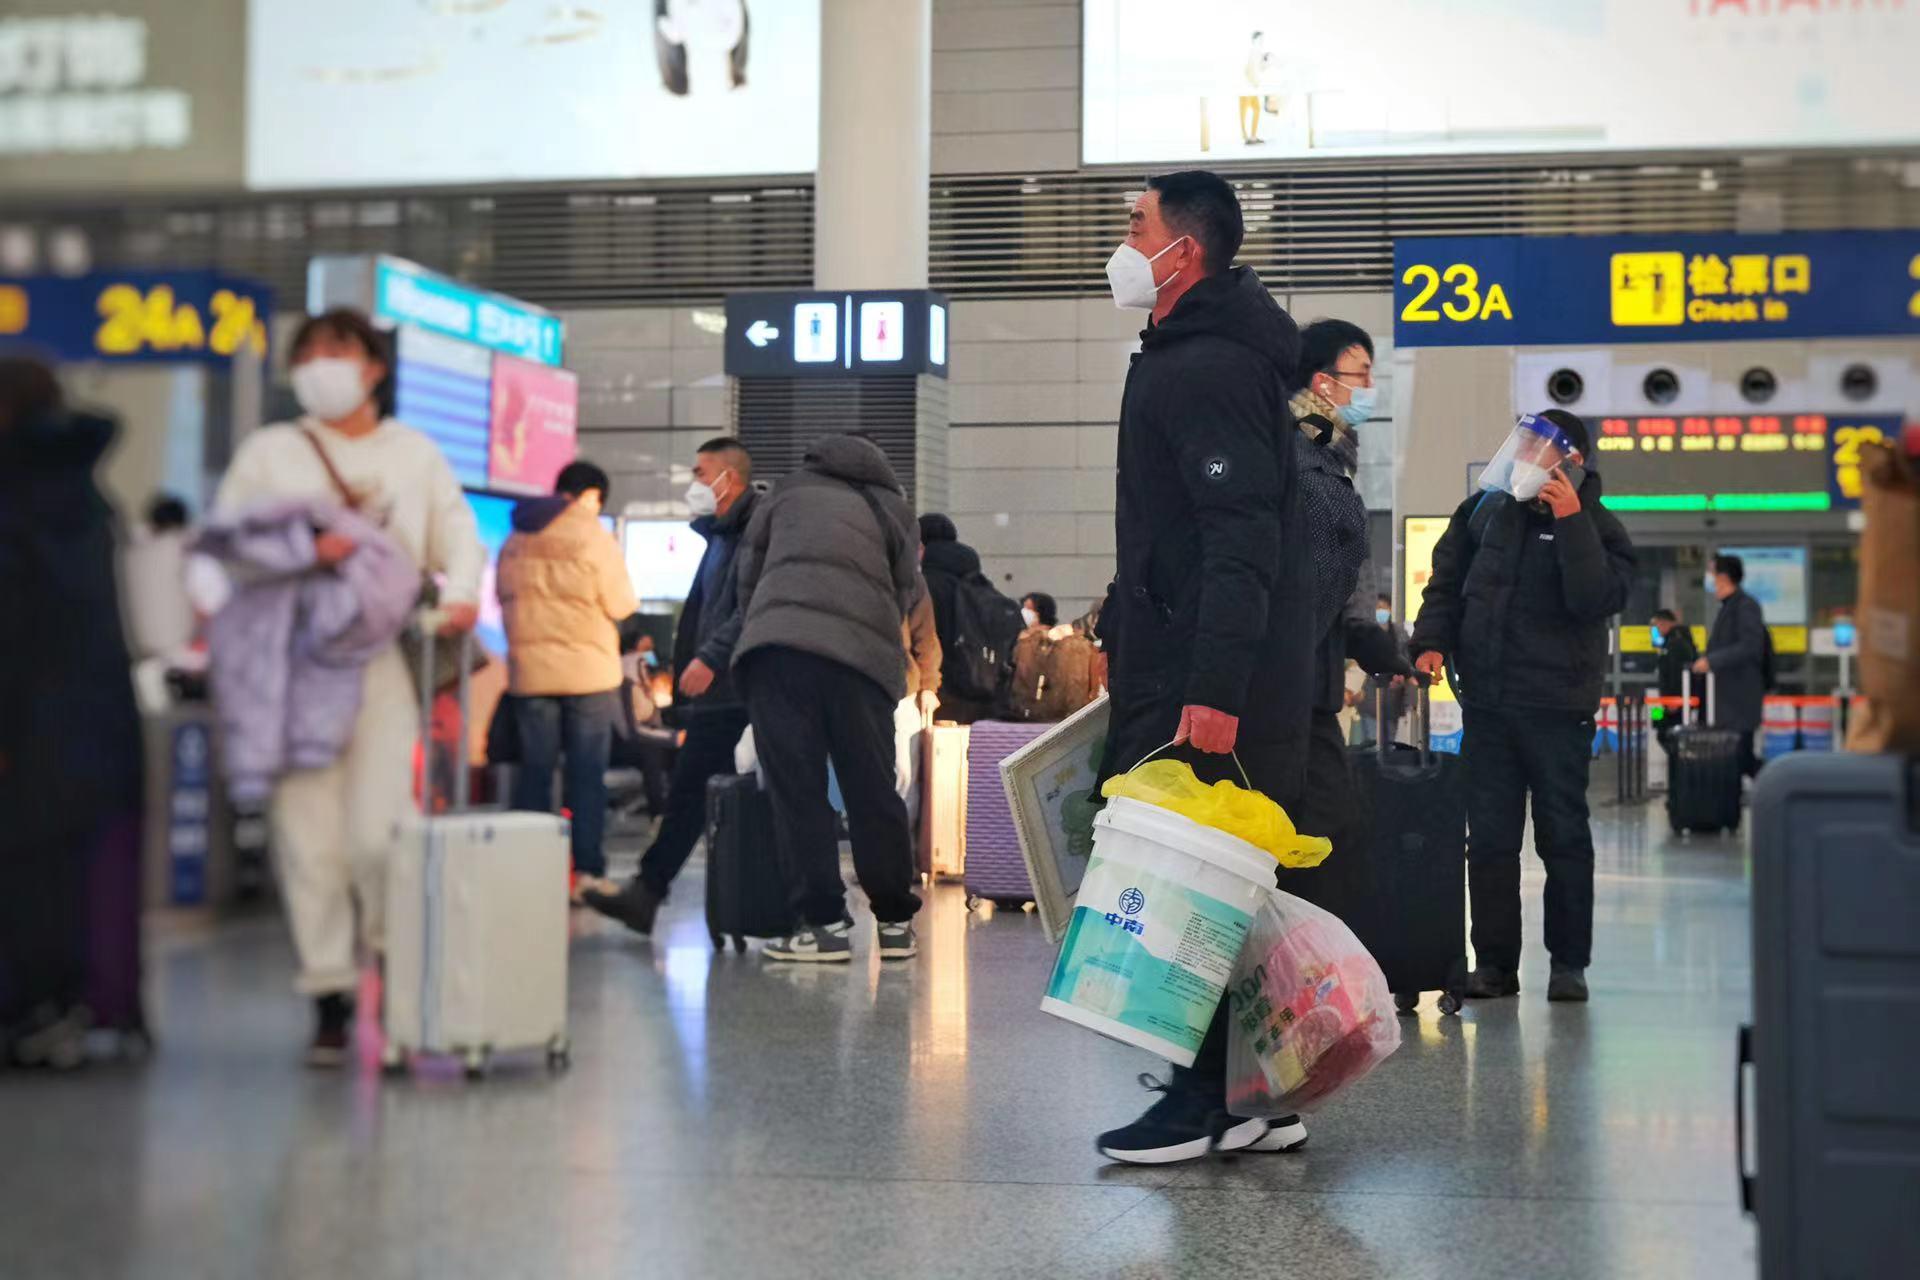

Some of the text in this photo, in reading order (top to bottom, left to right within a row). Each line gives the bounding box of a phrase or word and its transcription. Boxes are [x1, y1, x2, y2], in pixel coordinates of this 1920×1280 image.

[1401, 263, 1513, 322] 23A
[1687, 298, 1758, 322] Check
[1105, 913, 1144, 935] 中南
